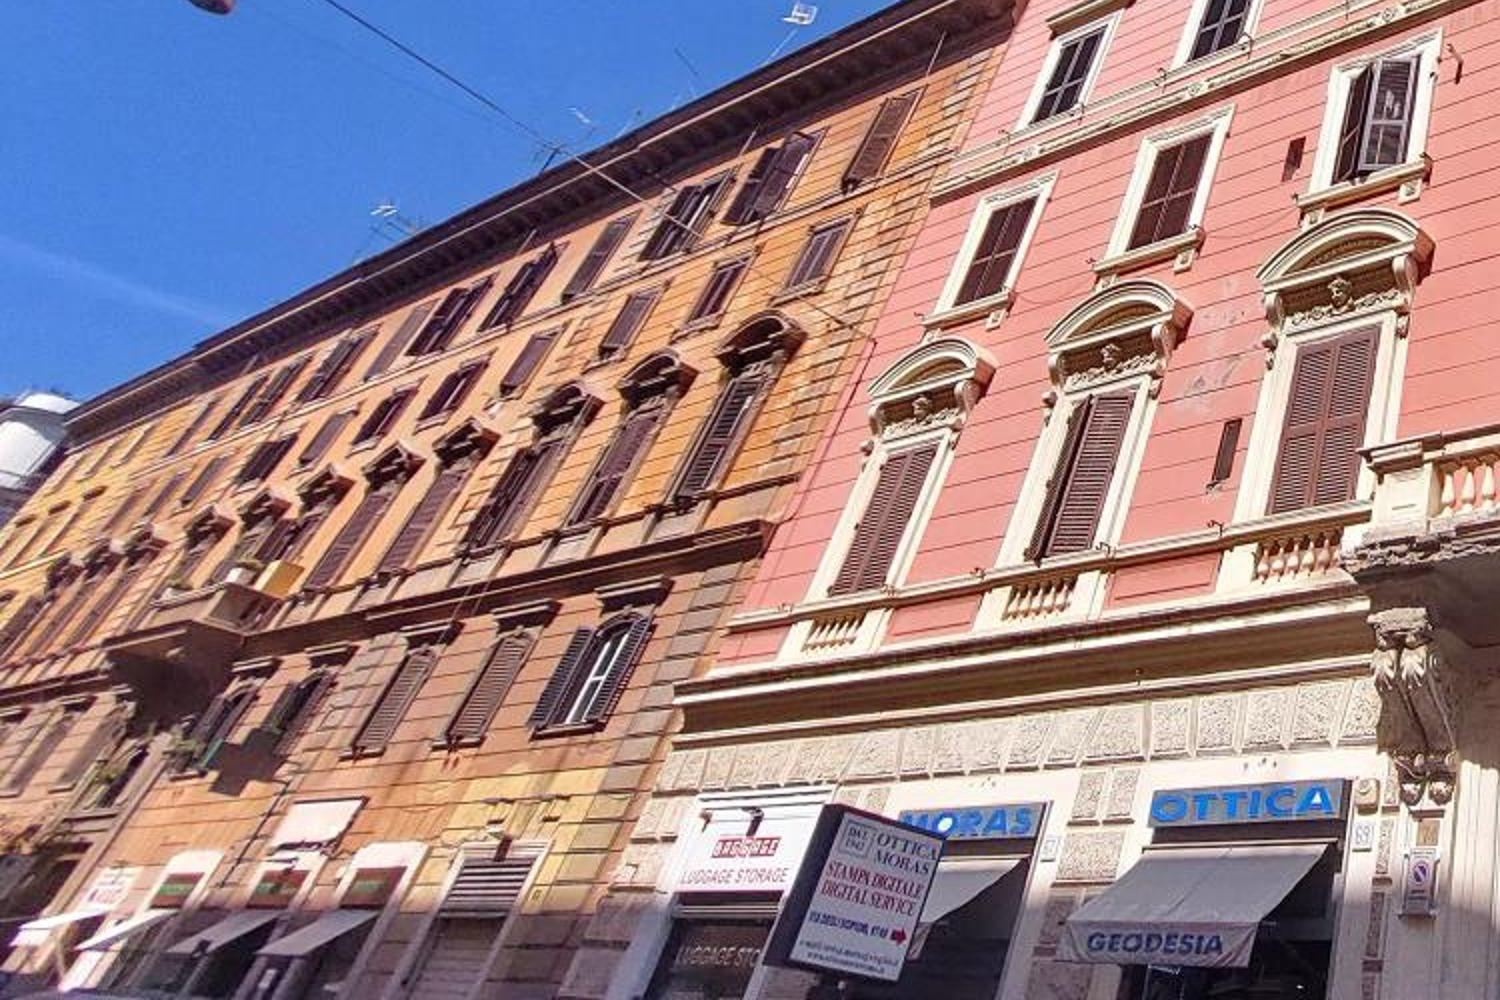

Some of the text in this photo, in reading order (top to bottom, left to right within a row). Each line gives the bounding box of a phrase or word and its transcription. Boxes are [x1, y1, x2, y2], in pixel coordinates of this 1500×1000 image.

[1152, 786, 1334, 822] OTTICA
[877, 833, 937, 860] OTTICA
[680, 867, 789, 884] LUGGAGE STORAGE
[874, 851, 929, 874] MORAS
[827, 861, 924, 898] STAMPA DIGITALE
[821, 880, 915, 916] DIGITAL SERVICE
[1088, 931, 1223, 954] GEODESIA
